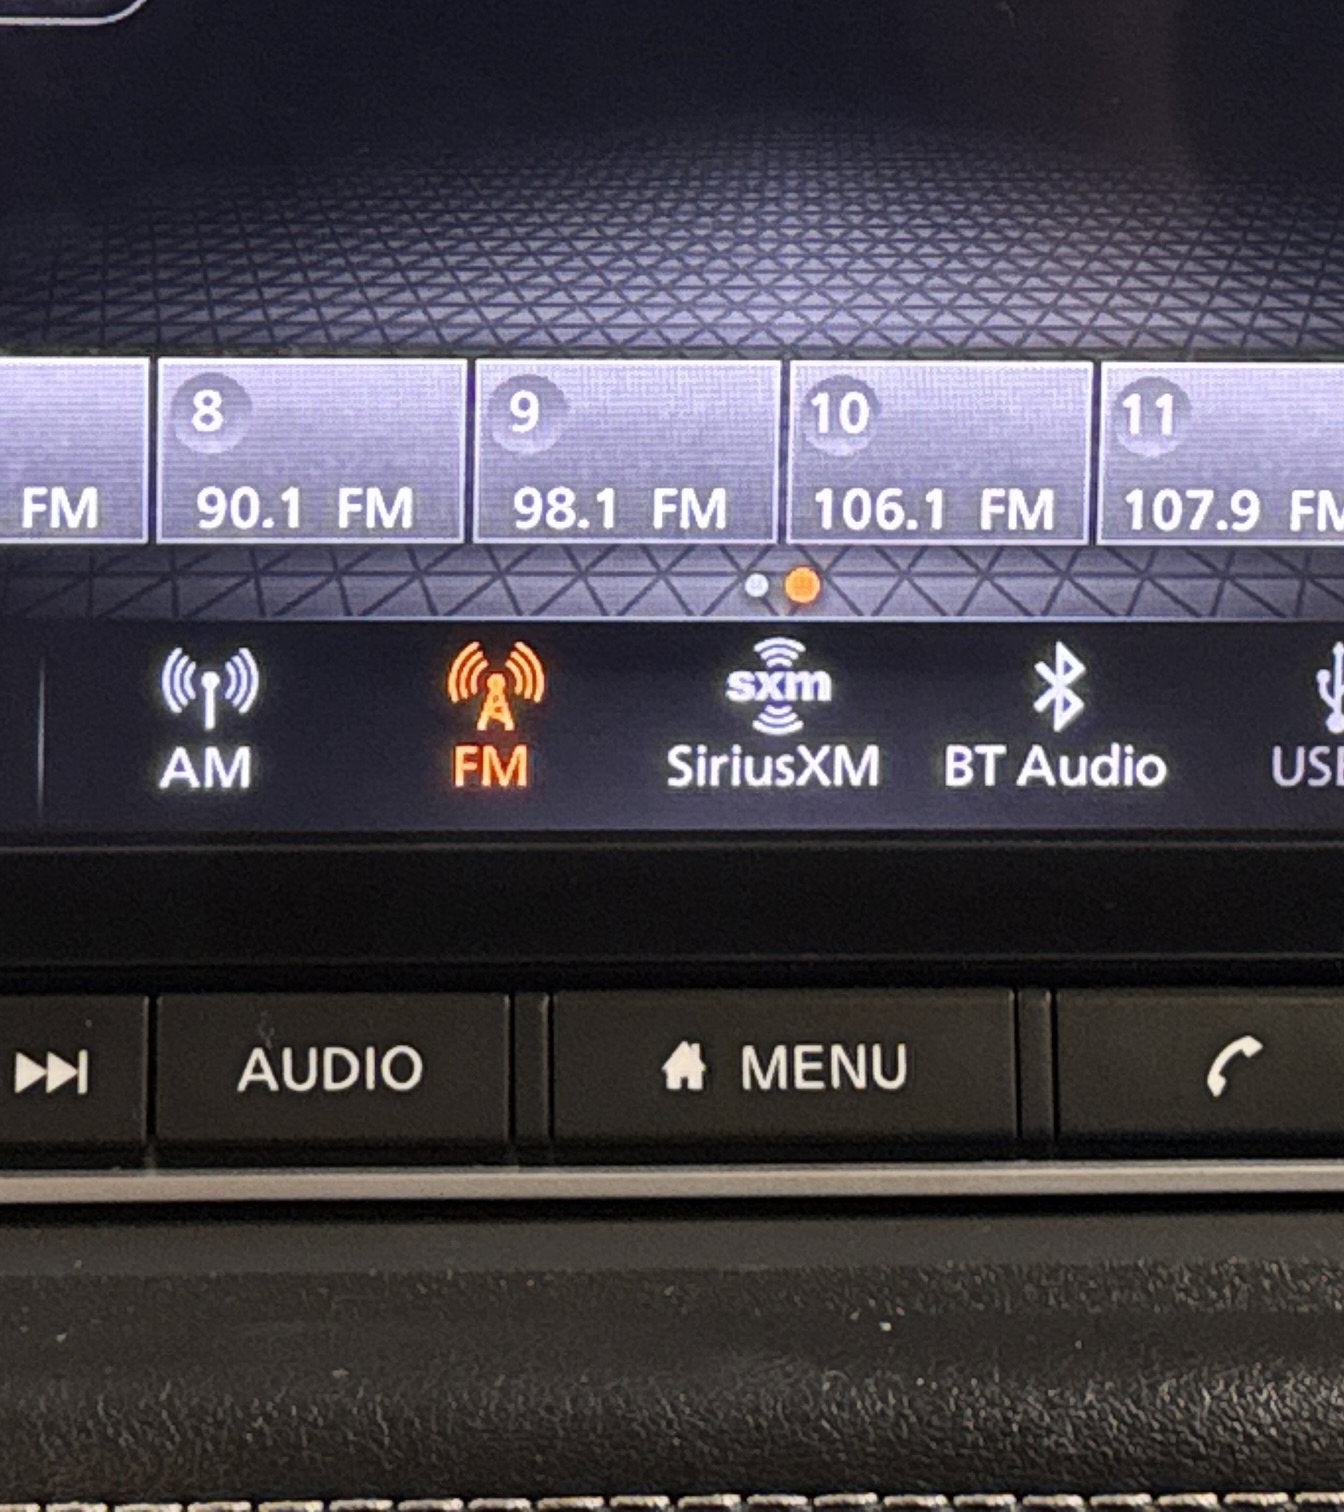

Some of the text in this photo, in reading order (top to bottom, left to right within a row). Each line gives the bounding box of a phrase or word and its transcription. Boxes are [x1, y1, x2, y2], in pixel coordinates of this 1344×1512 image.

[191, 389, 224, 432] 8
[509, 390, 540, 433] 9
[812, 390, 869, 434] 10
[1122, 392, 1174, 435] 11
[22, 487, 98, 529] FM
[197, 486, 413, 530] 90.1 FM
[513, 486, 727, 530] 98.1 FM
[814, 487, 1054, 531] 106.1 FM
[1125, 488, 1260, 532] 107.9
[726, 667, 832, 704] sxm
[160, 746, 253, 789] AM
[454, 746, 528, 788] FM
[666, 744, 880, 788] SiriusXM
[945, 743, 1167, 788] BT Audio
[238, 1044, 424, 1093] AUDIO
[741, 1043, 908, 1091] MENU
